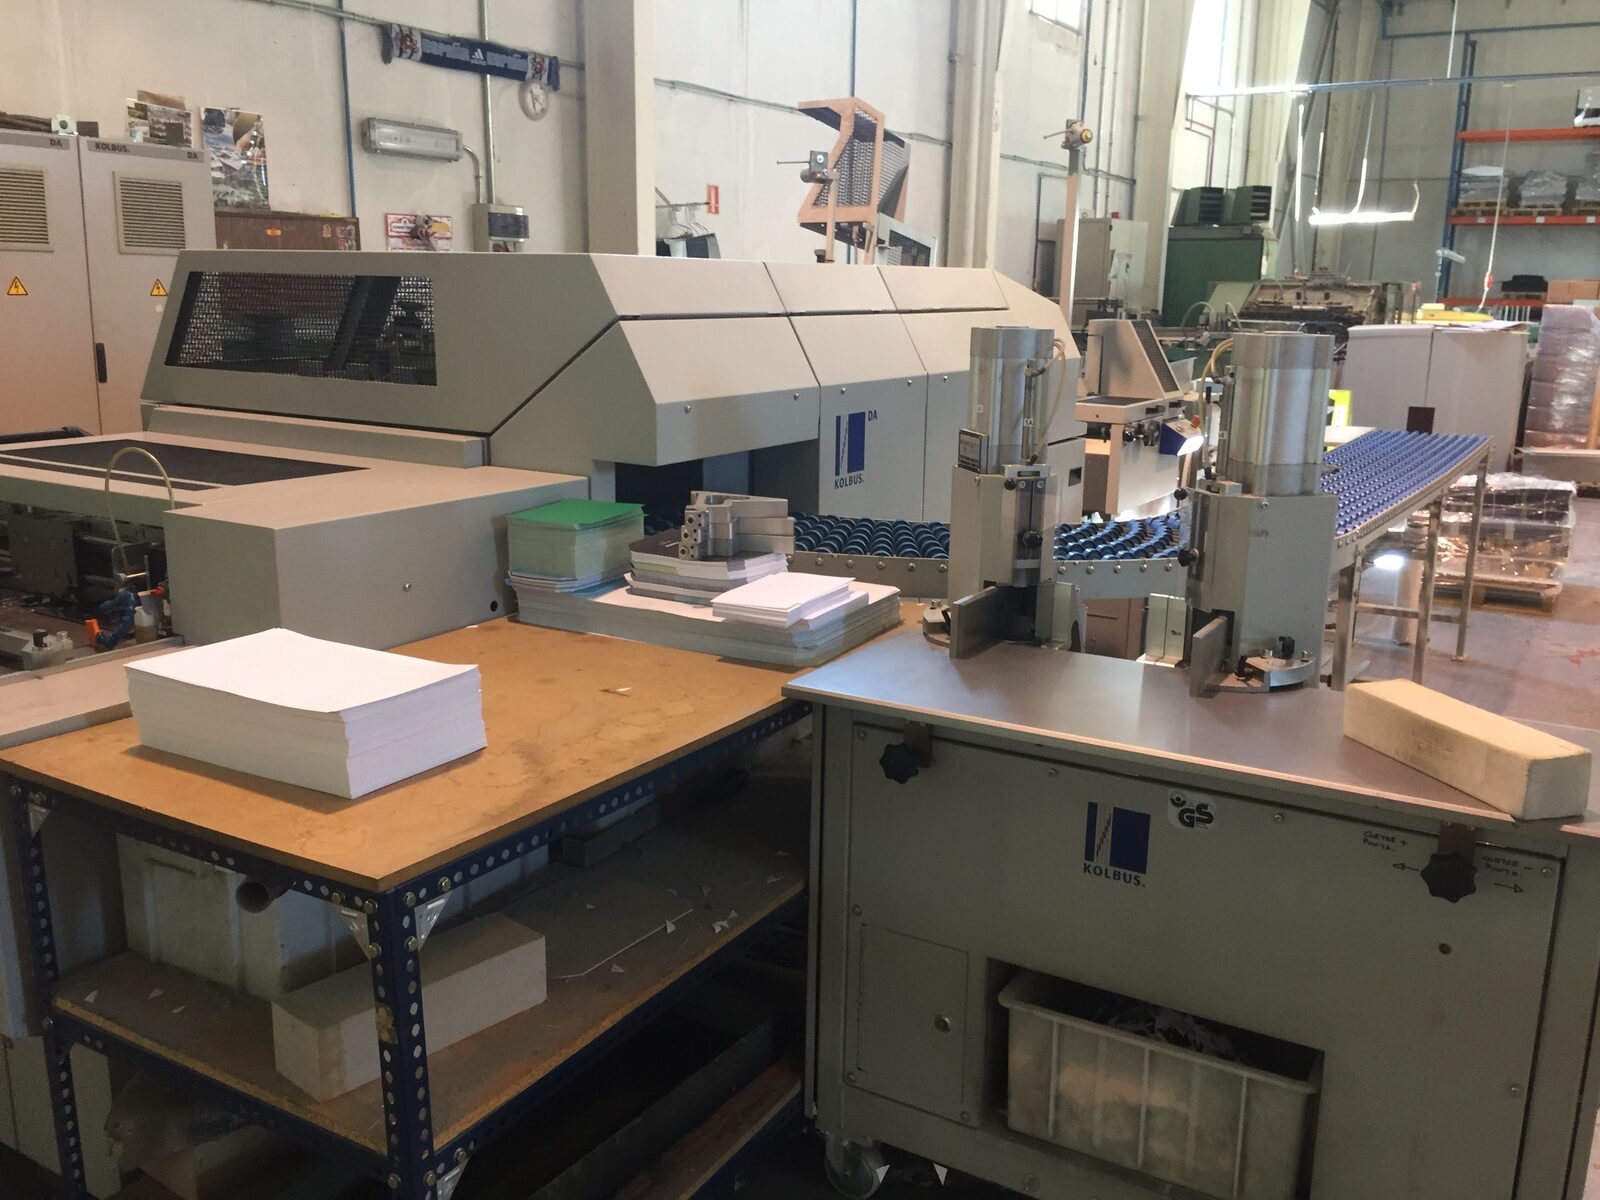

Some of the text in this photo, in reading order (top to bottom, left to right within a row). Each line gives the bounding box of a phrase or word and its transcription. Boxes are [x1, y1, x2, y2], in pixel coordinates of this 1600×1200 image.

[50, 138, 63, 147] DA
[868, 410, 878, 421] DA
[1178, 803, 1214, 828] GS
